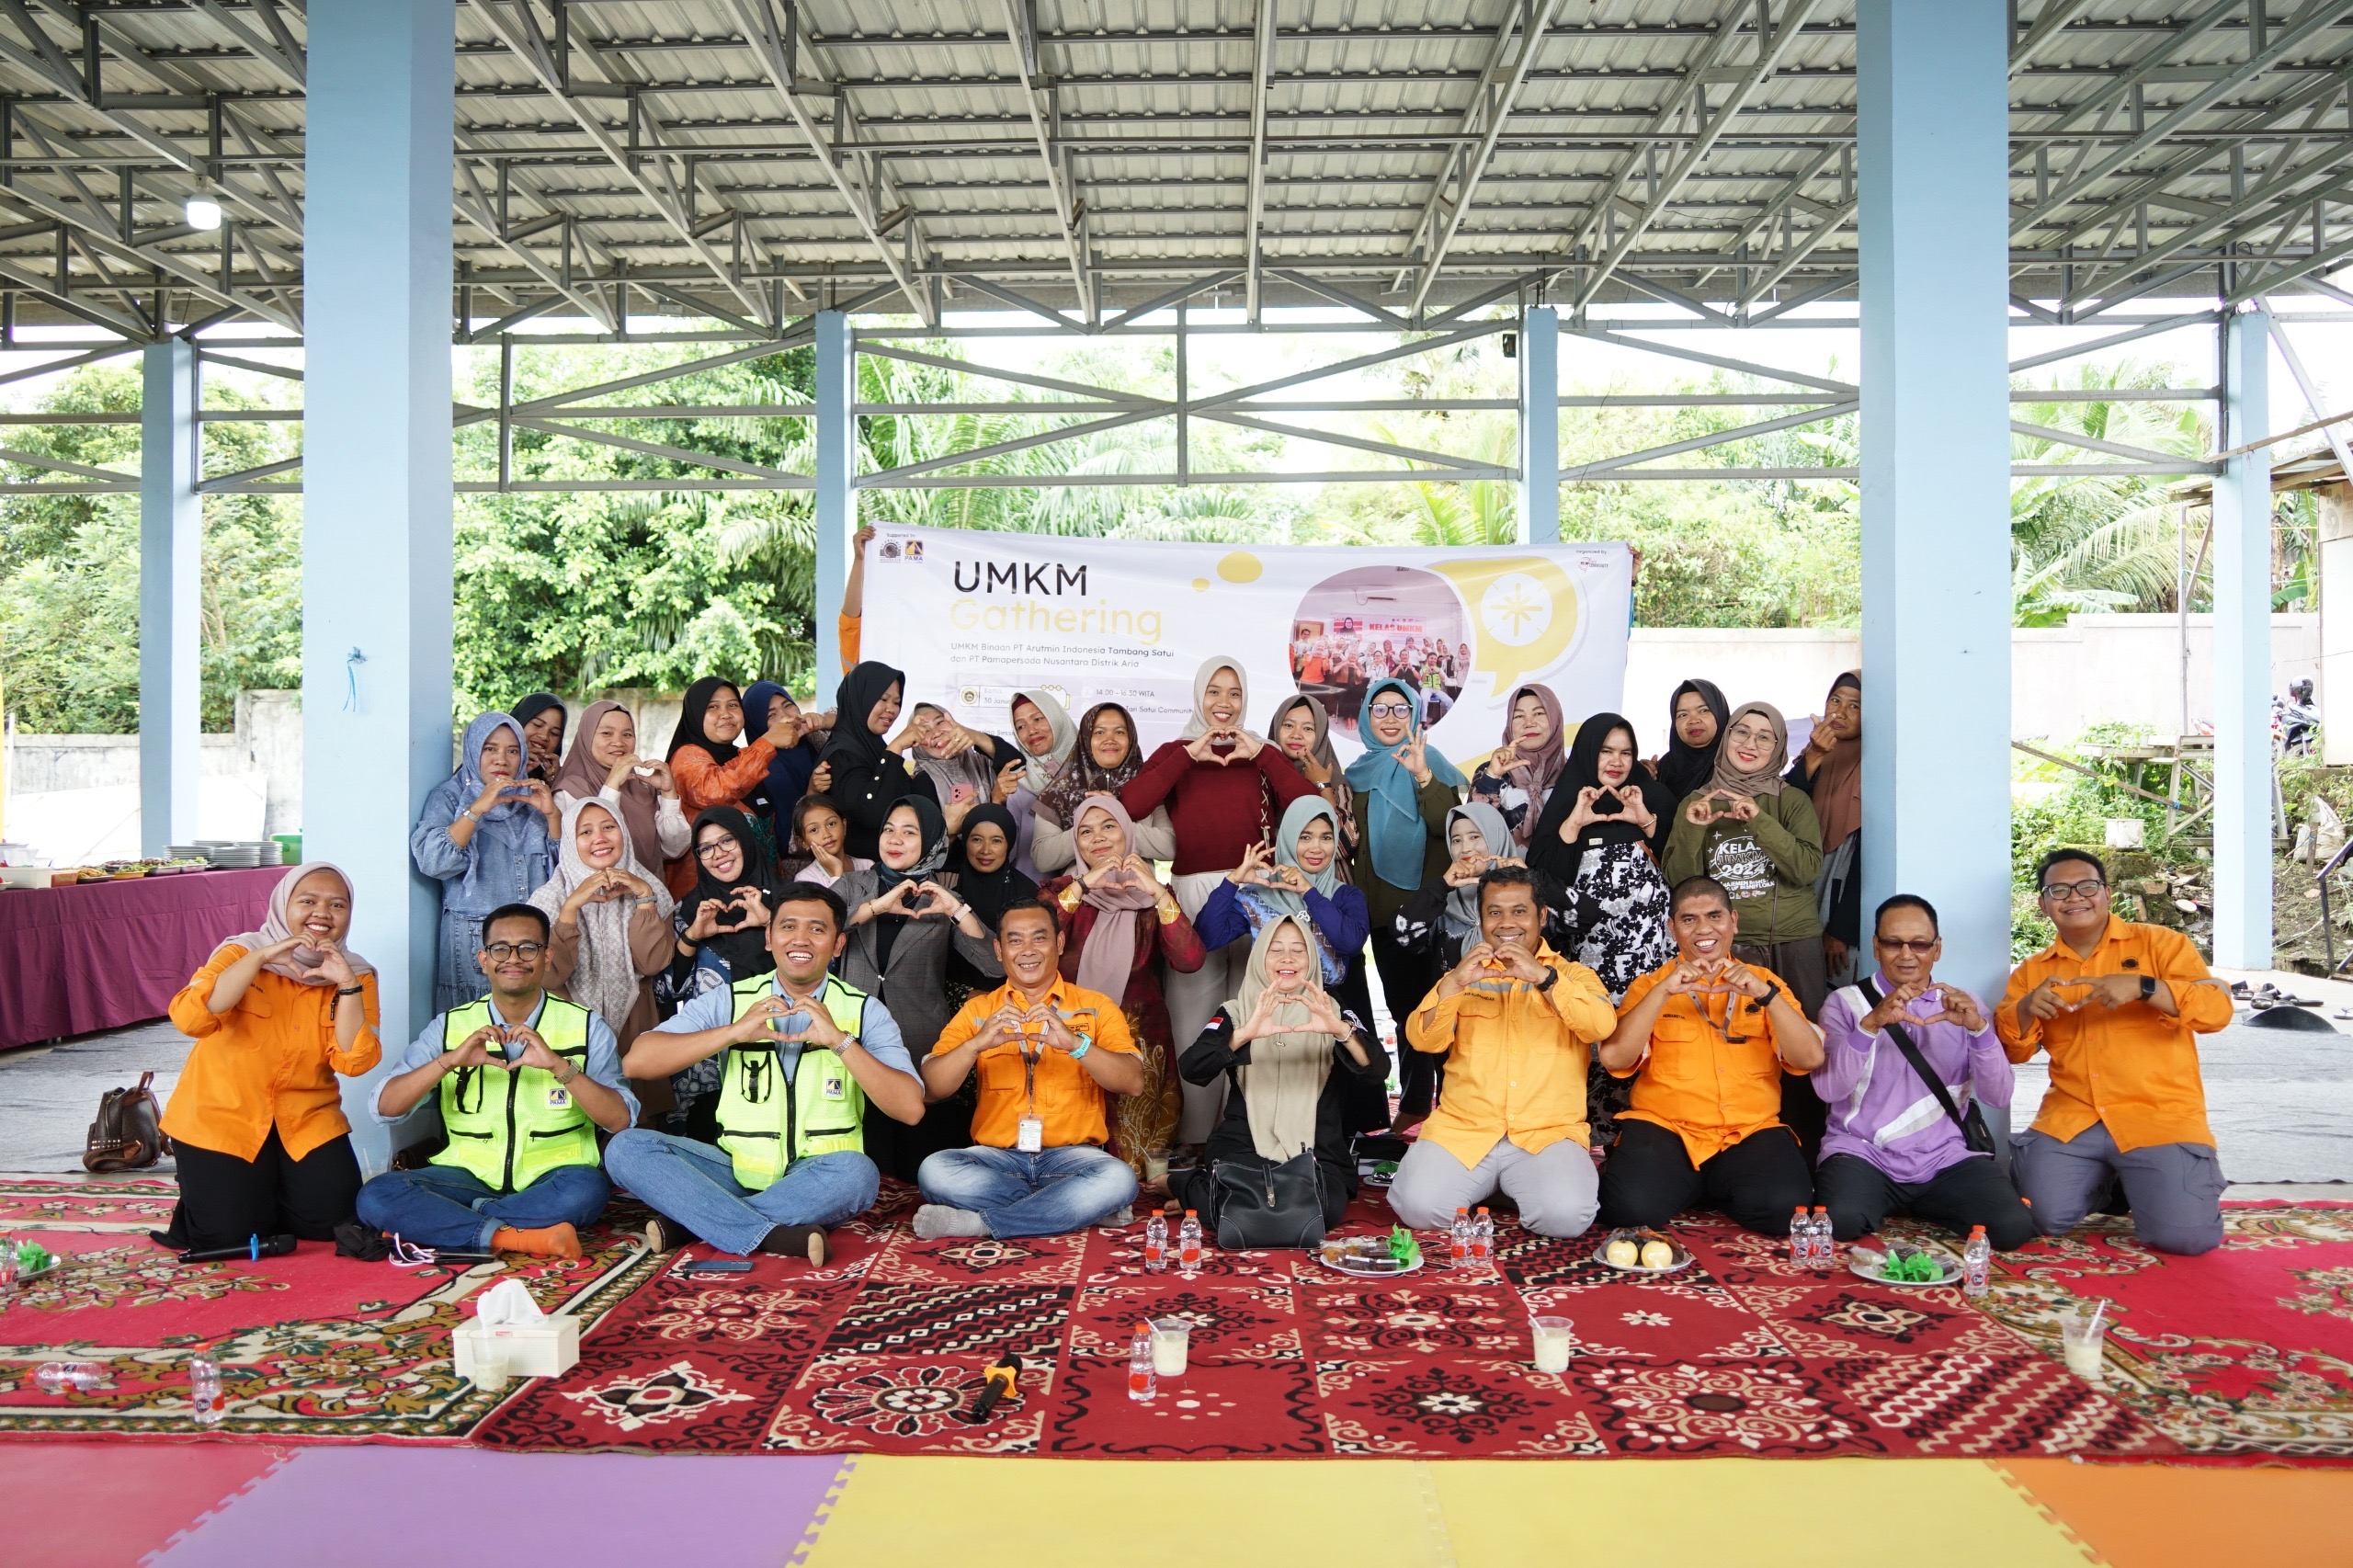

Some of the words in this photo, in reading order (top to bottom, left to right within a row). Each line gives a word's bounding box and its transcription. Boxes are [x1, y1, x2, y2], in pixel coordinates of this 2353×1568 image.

[954, 561, 1087, 597] UMKM
[949, 597, 1163, 646] Gathering
[950, 642, 978, 651] UMKM
[981, 643, 1011, 652] Binaan
[1026, 644, 1060, 653] Arutmin
[1063, 645, 1106, 654] Indonesia
[1108, 646, 1149, 657] Tambang
[1151, 649, 1175, 657] Satui
[950, 654, 966, 663] dan
[982, 655, 1041, 665] Pamapersada
[1043, 657, 1088, 665] Nusantara
[1091, 658, 1119, 666] Distrik
[1120, 659, 1140, 668] Aria
[983, 697, 992, 705] 30
[1719, 851, 1766, 865] UMKM
[1722, 862, 1766, 875] 2024
